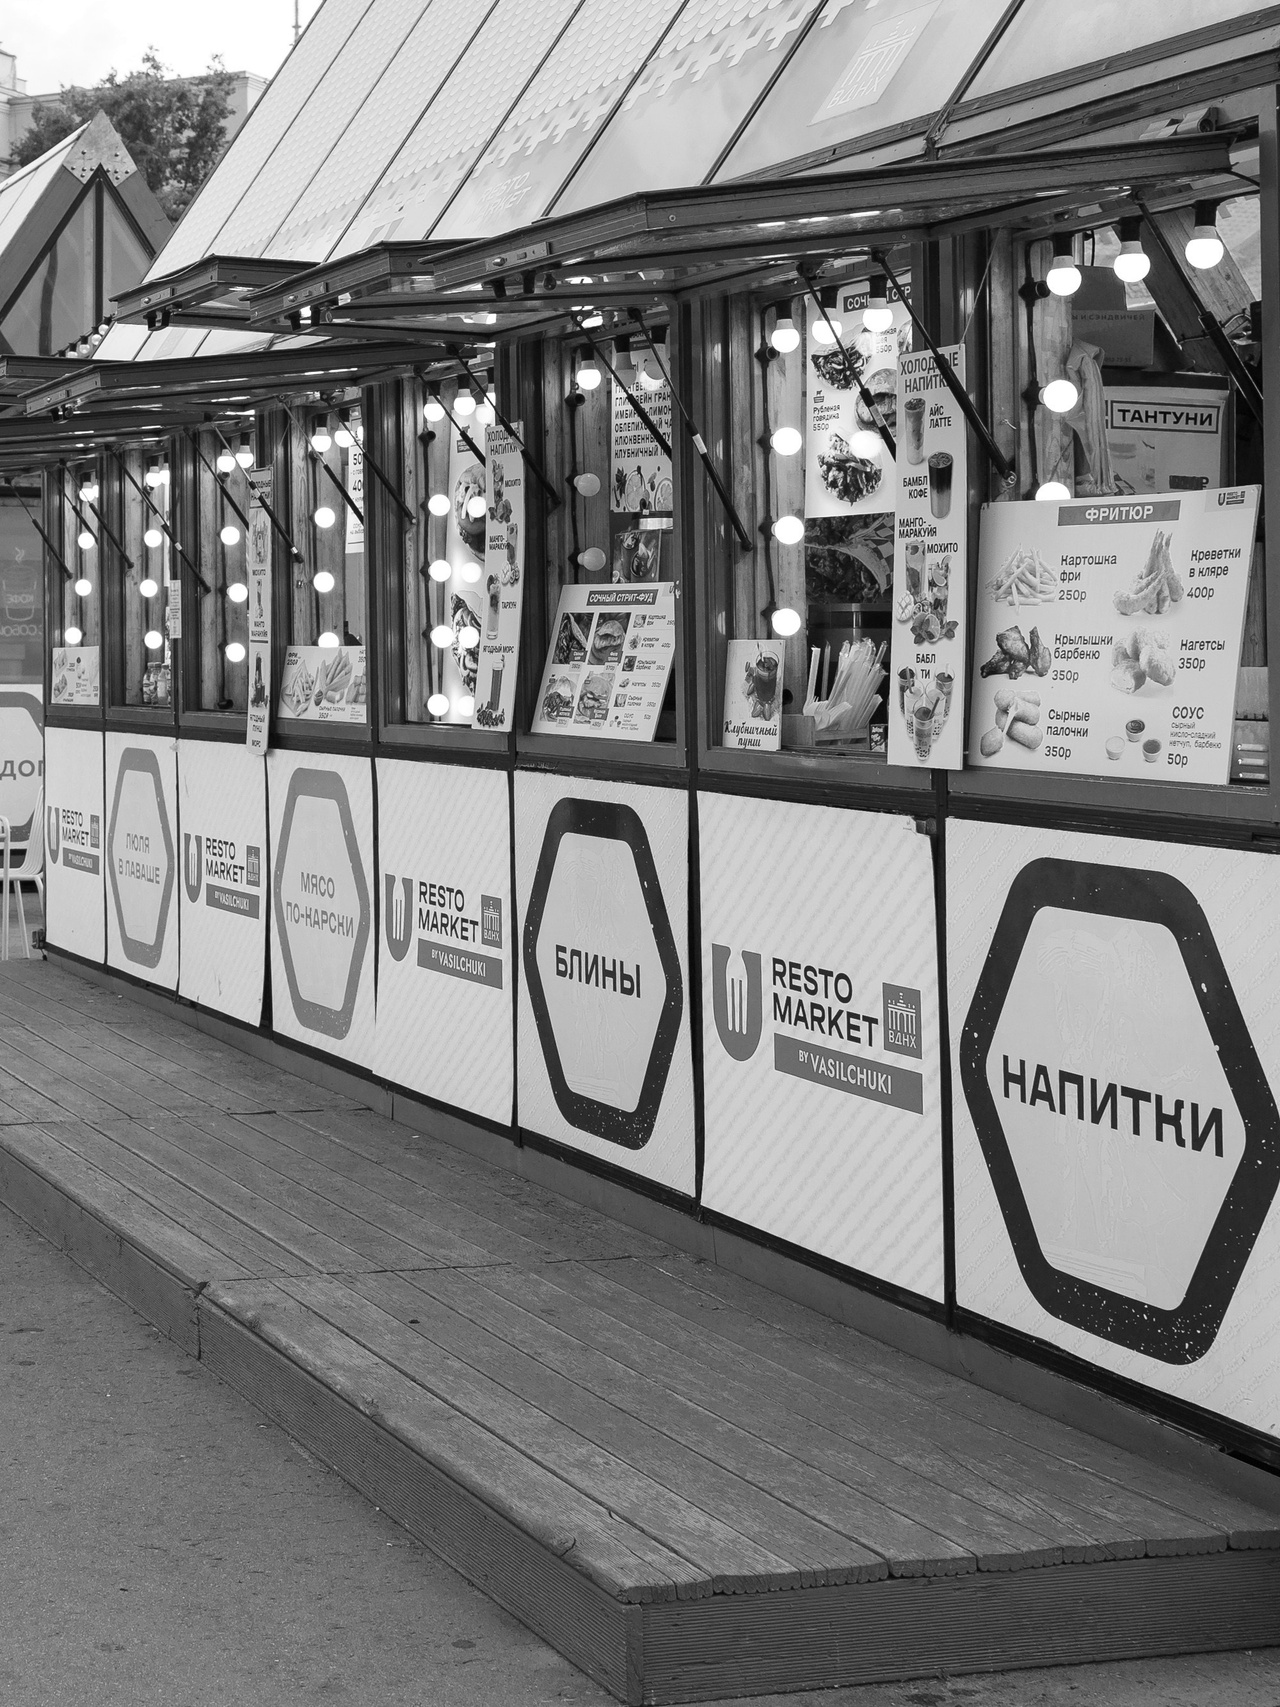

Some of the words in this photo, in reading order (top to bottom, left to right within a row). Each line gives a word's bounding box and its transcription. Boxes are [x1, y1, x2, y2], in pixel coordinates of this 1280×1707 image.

[901, 352, 959, 376] ХОЛОДЕ
[905, 373, 950, 393] НАПИТК
[929, 404, 944, 417] АЙС
[1117, 408, 1213, 426] ТАНТУНИ
[929, 416, 952, 428] ЛАТТЕ
[903, 475, 928, 487] БАМБЛ
[908, 488, 928, 499] КОФЕ
[1085, 505, 1154, 522] ФРИТЮР
[899, 517, 927, 528] МАНГО-
[899, 524, 937, 538] МАРАКУЙЯ
[927, 542, 959, 554] МОХИТО
[1061, 554, 1117, 568] Картошка
[1191, 548, 1241, 563] Креветки
[1060, 570, 1081, 583] фри
[1189, 567, 1195, 577] в
[1198, 565, 1229, 578] кляре
[589, 592, 616, 603] СОЧНЫЙ
[617, 592, 654, 603] СТРИТ-ФУД
[1058, 589, 1087, 602] 250р
[1187, 586, 1214, 600] 400р
[1055, 633, 1113, 648] Крылышки
[1180, 638, 1226, 651] Нагетсы
[916, 653, 936, 664] БАБЛ
[1054, 647, 1101, 661] барбекю
[1178, 657, 1206, 671] 350р
[920, 669, 930, 679] ТИ
[1052, 669, 1079, 683] 350р
[1048, 709, 1090, 722] Сырные
[1172, 706, 1205, 720] СОУС
[724, 720, 778, 737] Клубничный
[1047, 725, 1089, 738] палочки
[1171, 722, 1196, 730] сырный
[738, 736, 762, 749] пунш
[1045, 746, 1071, 760] 350р
[1167, 753, 1188, 767] 50р
[62, 808, 83, 827] RESTO
[62, 826, 89, 847] MARKET
[125, 832, 150, 854] ЛЮЛЯ
[205, 837, 236, 861] RESTO
[118, 858, 123, 875] В
[124, 859, 160, 885] ЛАВАШЕ
[205, 858, 244, 884] MARKET
[300, 871, 335, 899] МЯСО
[419, 881, 465, 913] RESTO
[286, 901, 354, 939] ПО-КАРСКИ
[418, 907, 479, 943] MARKET
[483, 929, 500, 942] ВДНХ
[438, 951, 486, 977] VASILCHUKI
[555, 944, 641, 999] БЛИНЫ
[772, 957, 853, 1004] RESTO
[773, 992, 879, 1047] MARKET
[888, 1030, 917, 1049] ВДНХ
[798, 1050, 808, 1063] BY
[810, 1053, 892, 1095] VASILCHUKI
[1002, 1054, 1224, 1158] НАПИТКИ
